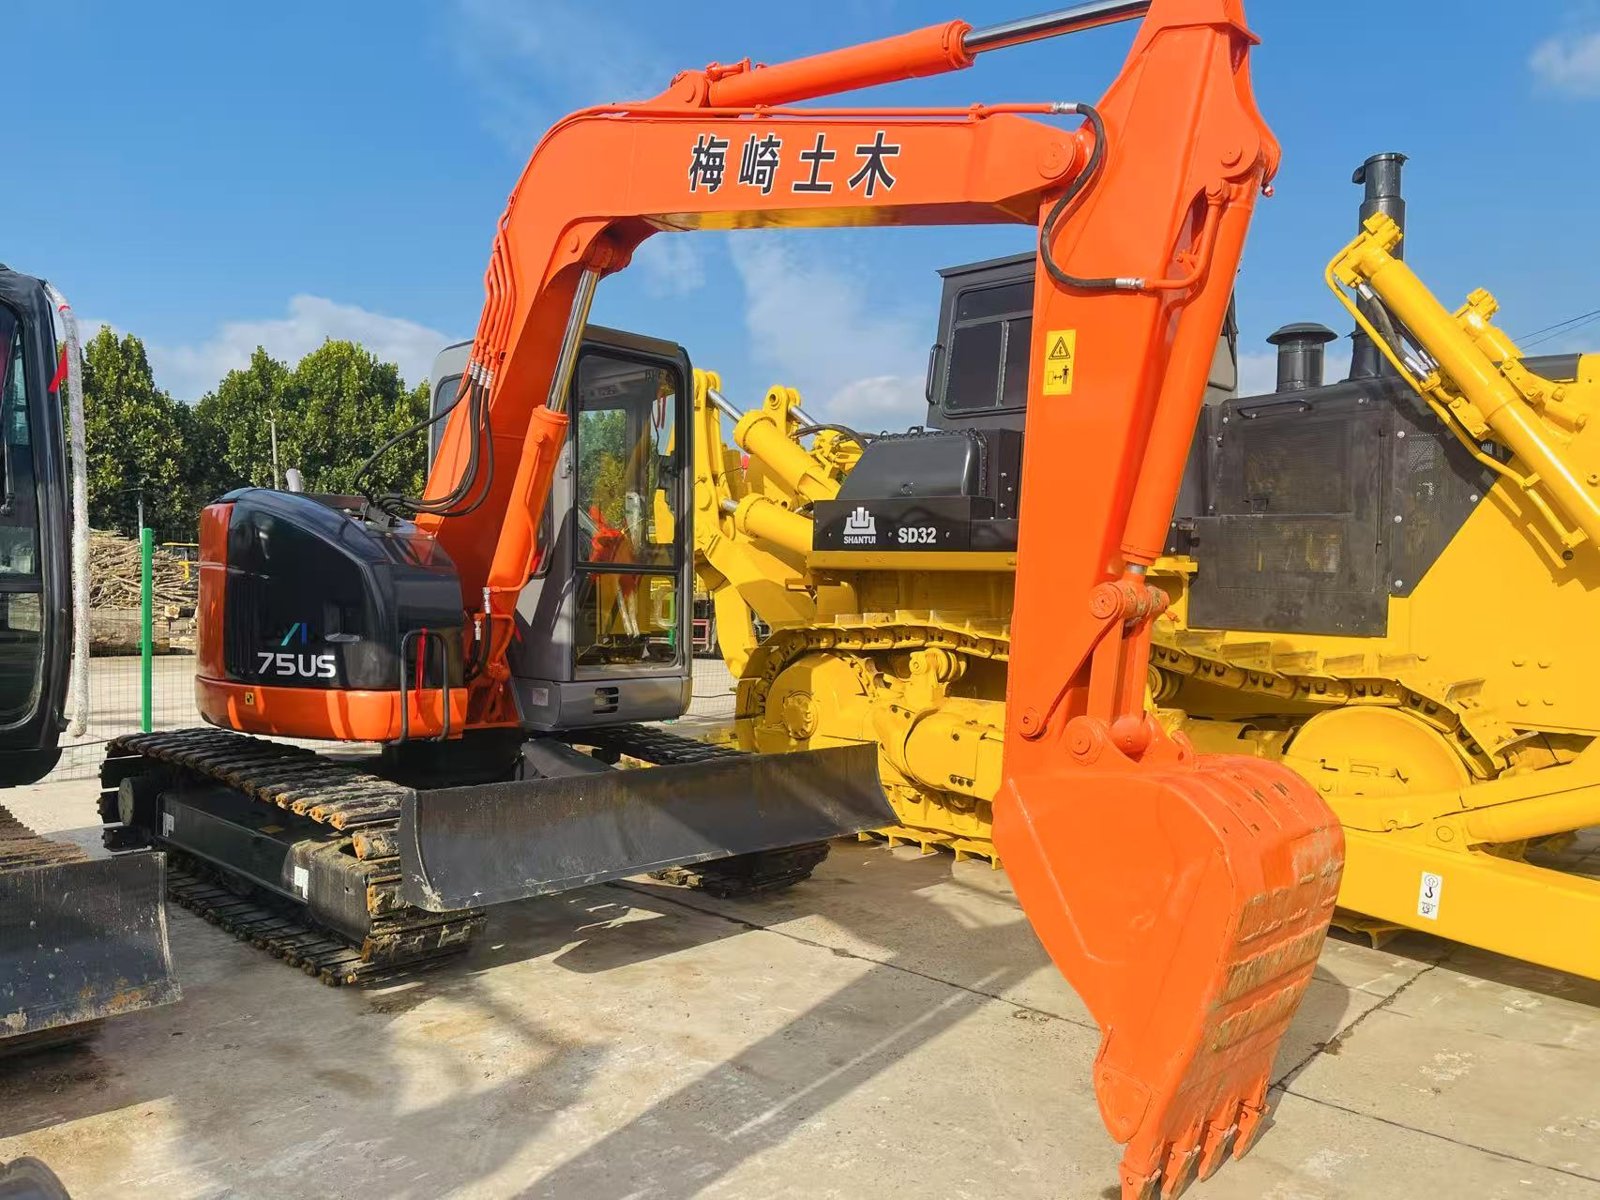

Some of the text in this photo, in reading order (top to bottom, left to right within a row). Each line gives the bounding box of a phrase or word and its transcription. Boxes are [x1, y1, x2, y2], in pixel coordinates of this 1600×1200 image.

[689, 130, 901, 198] 梅崎土木
[843, 536, 876, 544] SHANTUI
[897, 526, 937, 544] SD32
[257, 652, 336, 678] 75US
